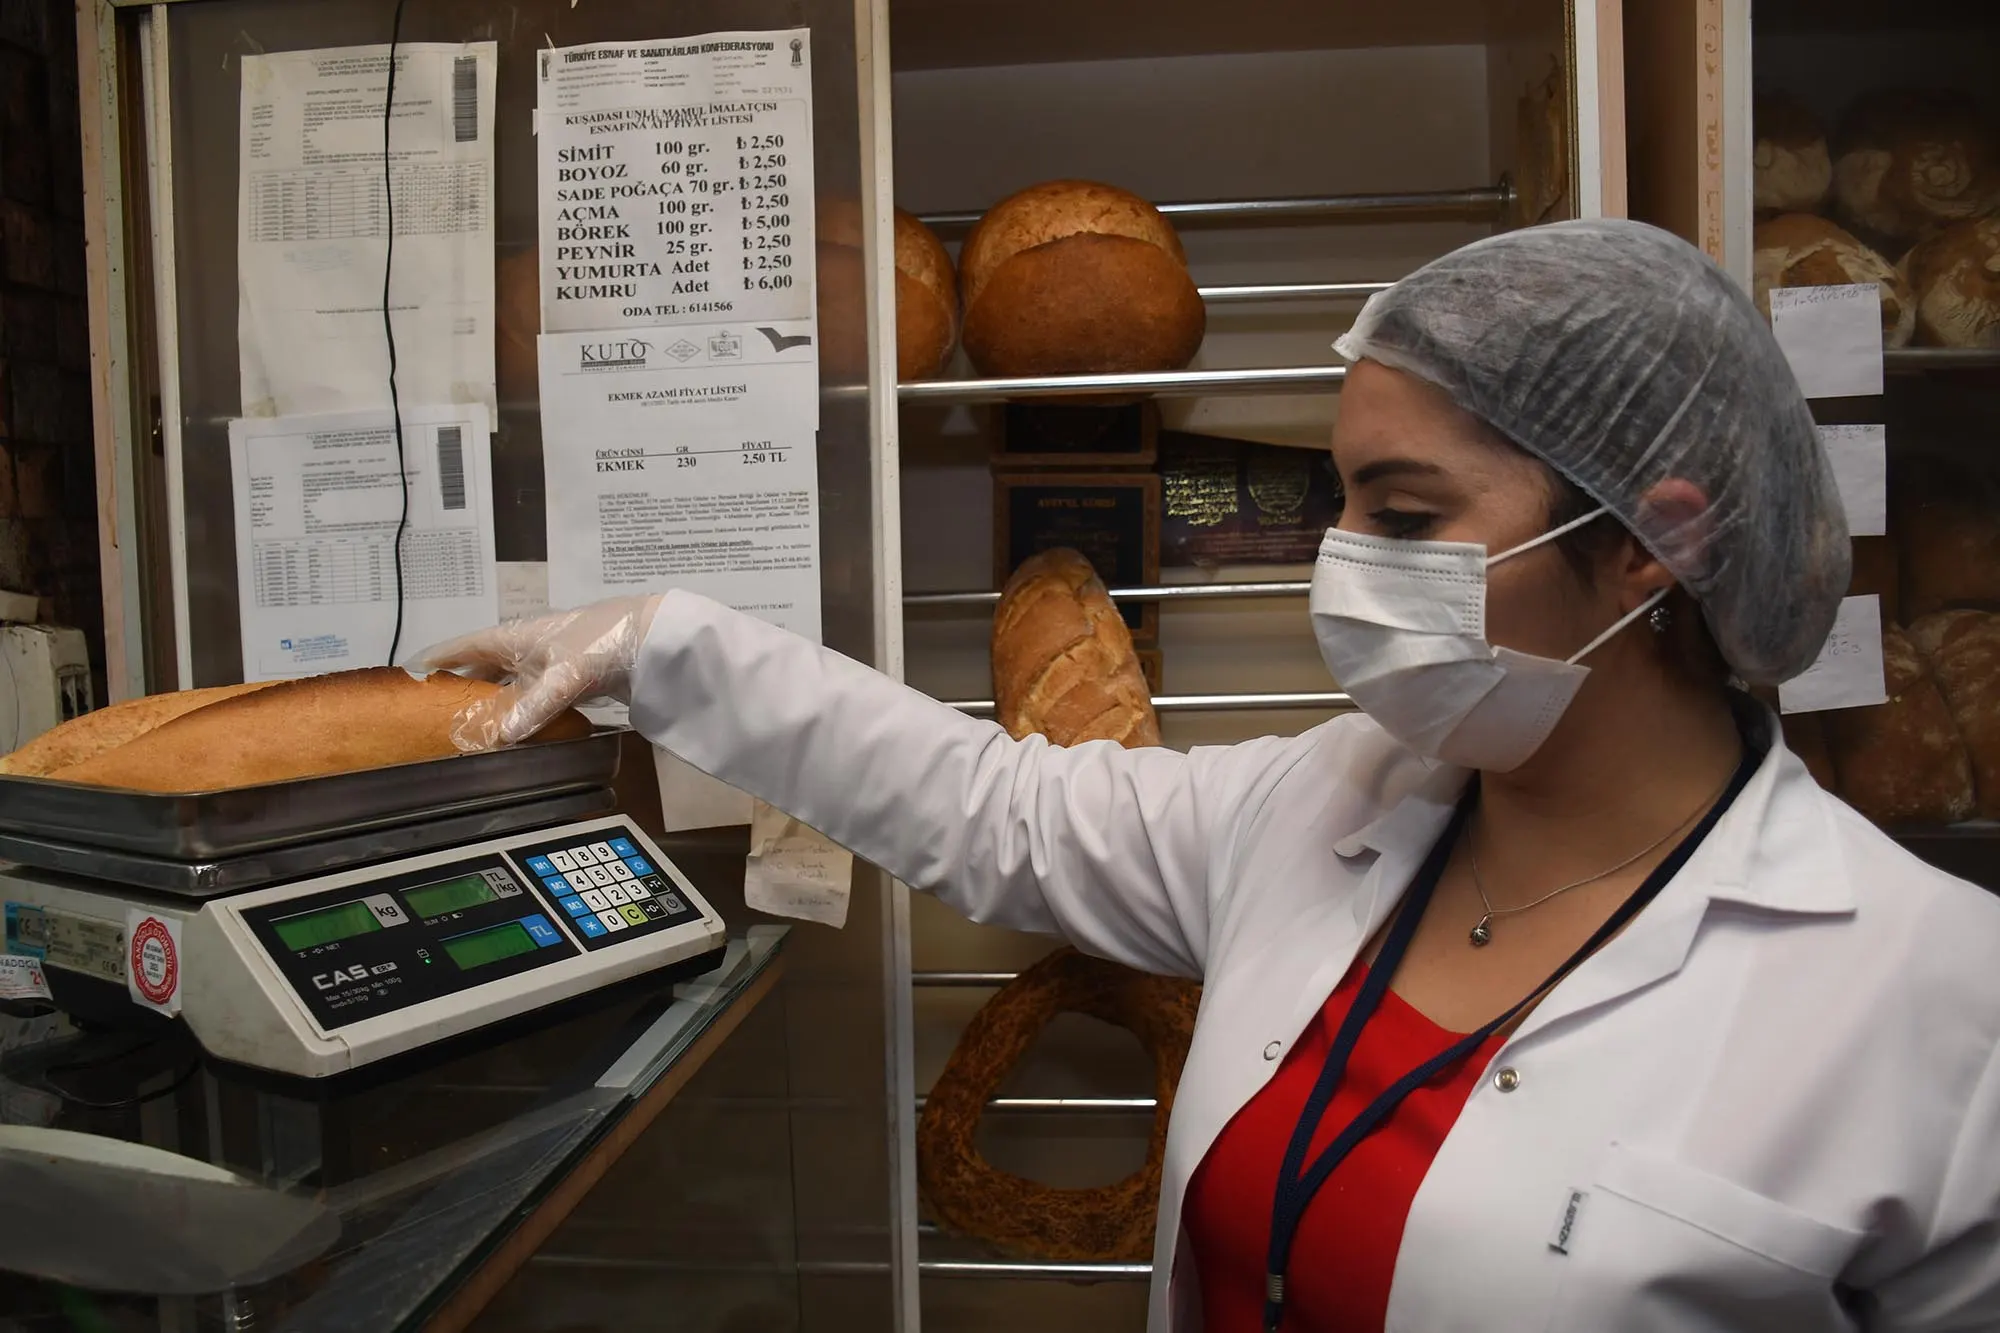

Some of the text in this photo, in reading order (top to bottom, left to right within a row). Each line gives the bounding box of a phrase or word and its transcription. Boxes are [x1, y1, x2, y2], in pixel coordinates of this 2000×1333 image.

[564, 49, 597, 63] TÜRKİYE
[598, 49, 625, 60] ESNAF
[627, 49, 638, 58] VE
[700, 41, 775, 54] KONFEDERASYONU
[565, 111, 622, 125] KUŞADASI
[709, 102, 777, 114] İMALATÇISI
[711, 113, 753, 126] LİSTESİ
[558, 143, 615, 163] SİMİT
[656, 140, 683, 155] 100
[688, 142, 710, 158] gr.
[751, 134, 784, 151] 2,50
[559, 163, 628, 182] BOYOZ
[661, 160, 681, 174] 60
[685, 162, 708, 177] gr.
[753, 154, 786, 171] 2,50
[557, 187, 605, 201] SADE
[610, 180, 684, 198] POĞAÇA
[689, 179, 708, 193] 70
[712, 181, 734, 195] gr.
[754, 174, 787, 191] 2,50
[557, 205, 620, 223] AÇMA
[659, 199, 686, 215] 100
[691, 202, 714, 217] gr.
[756, 193, 789, 210] 2,50
[557, 223, 630, 241] BÖREK
[657, 220, 685, 235] 100
[689, 222, 712, 237] gr.
[756, 214, 790, 231] 5,00
[557, 241, 636, 260] PEYNİR
[666, 240, 685, 254] 25
[690, 242, 713, 257] gr.
[757, 233, 791, 251] 2,50
[556, 262, 662, 280] YUMURTA
[672, 260, 710, 274] Adet
[758, 254, 792, 271] 2,50
[557, 284, 637, 300] KUMRU
[672, 280, 709, 294] Adet
[759, 274, 793, 291] 6,00
[623, 306, 652, 317] ODA
[655, 304, 679, 316] TEL
[688, 301, 733, 313] 6141566
[581, 341, 646, 360] KUTO
[608, 384, 747, 402] EKMEK AZAMİ FİYAT LİSTESİ
[676, 446, 689, 454] GR
[741, 441, 772, 450] FİYATI
[596, 452, 787, 473] EKMEK 230 2,50 TL
[578, 851, 589, 862] 8
[598, 846, 609, 857] 9
[534, 861, 550, 871] M1
[556, 855, 568, 867] 7
[486, 872, 506, 882] TL
[594, 870, 606, 881] 5
[614, 865, 626, 876] 6
[550, 880, 566, 890] M2
[575, 875, 585, 886] 4
[611, 889, 623, 901] 2
[630, 884, 642, 895] 3
[567, 901, 583, 910] M3
[591, 895, 602, 906] 1
[374, 905, 398, 918] kg
[627, 908, 640, 919] C
[607, 914, 618, 926] 0
[530, 924, 553, 938] TL
[311, 963, 370, 990] CAS
